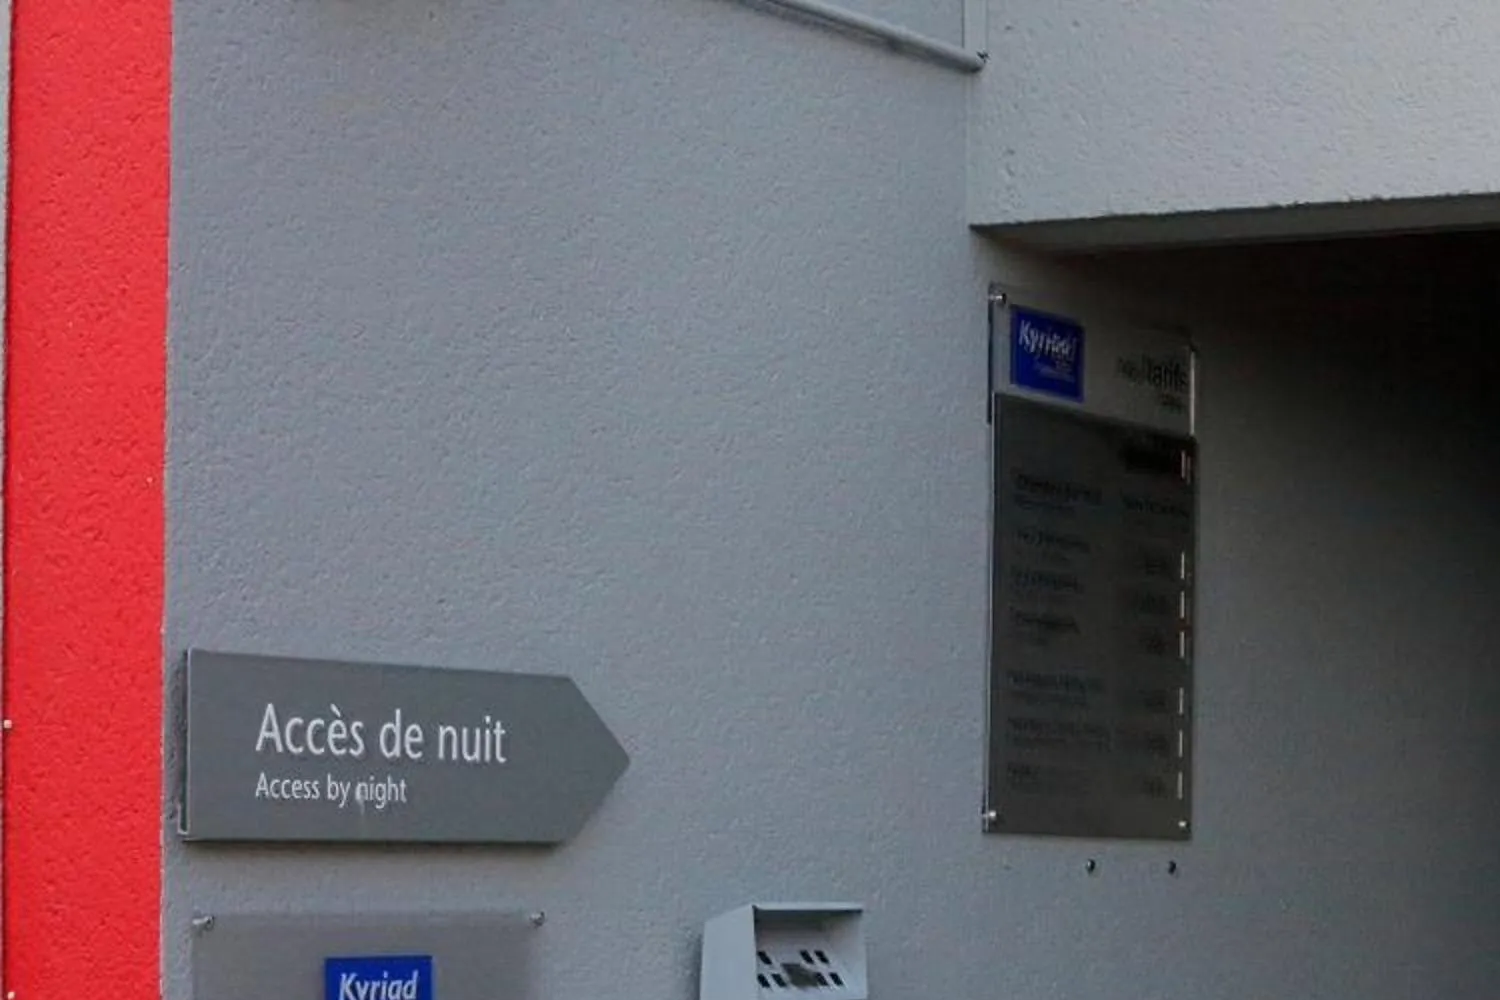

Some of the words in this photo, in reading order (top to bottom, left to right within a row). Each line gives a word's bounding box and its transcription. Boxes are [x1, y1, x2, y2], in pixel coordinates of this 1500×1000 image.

[255, 702, 365, 756] Accès
[379, 708, 424, 759] de
[438, 715, 507, 763] nuit
[255, 771, 320, 800] Access
[327, 772, 350, 808] by
[355, 774, 406, 809] night
